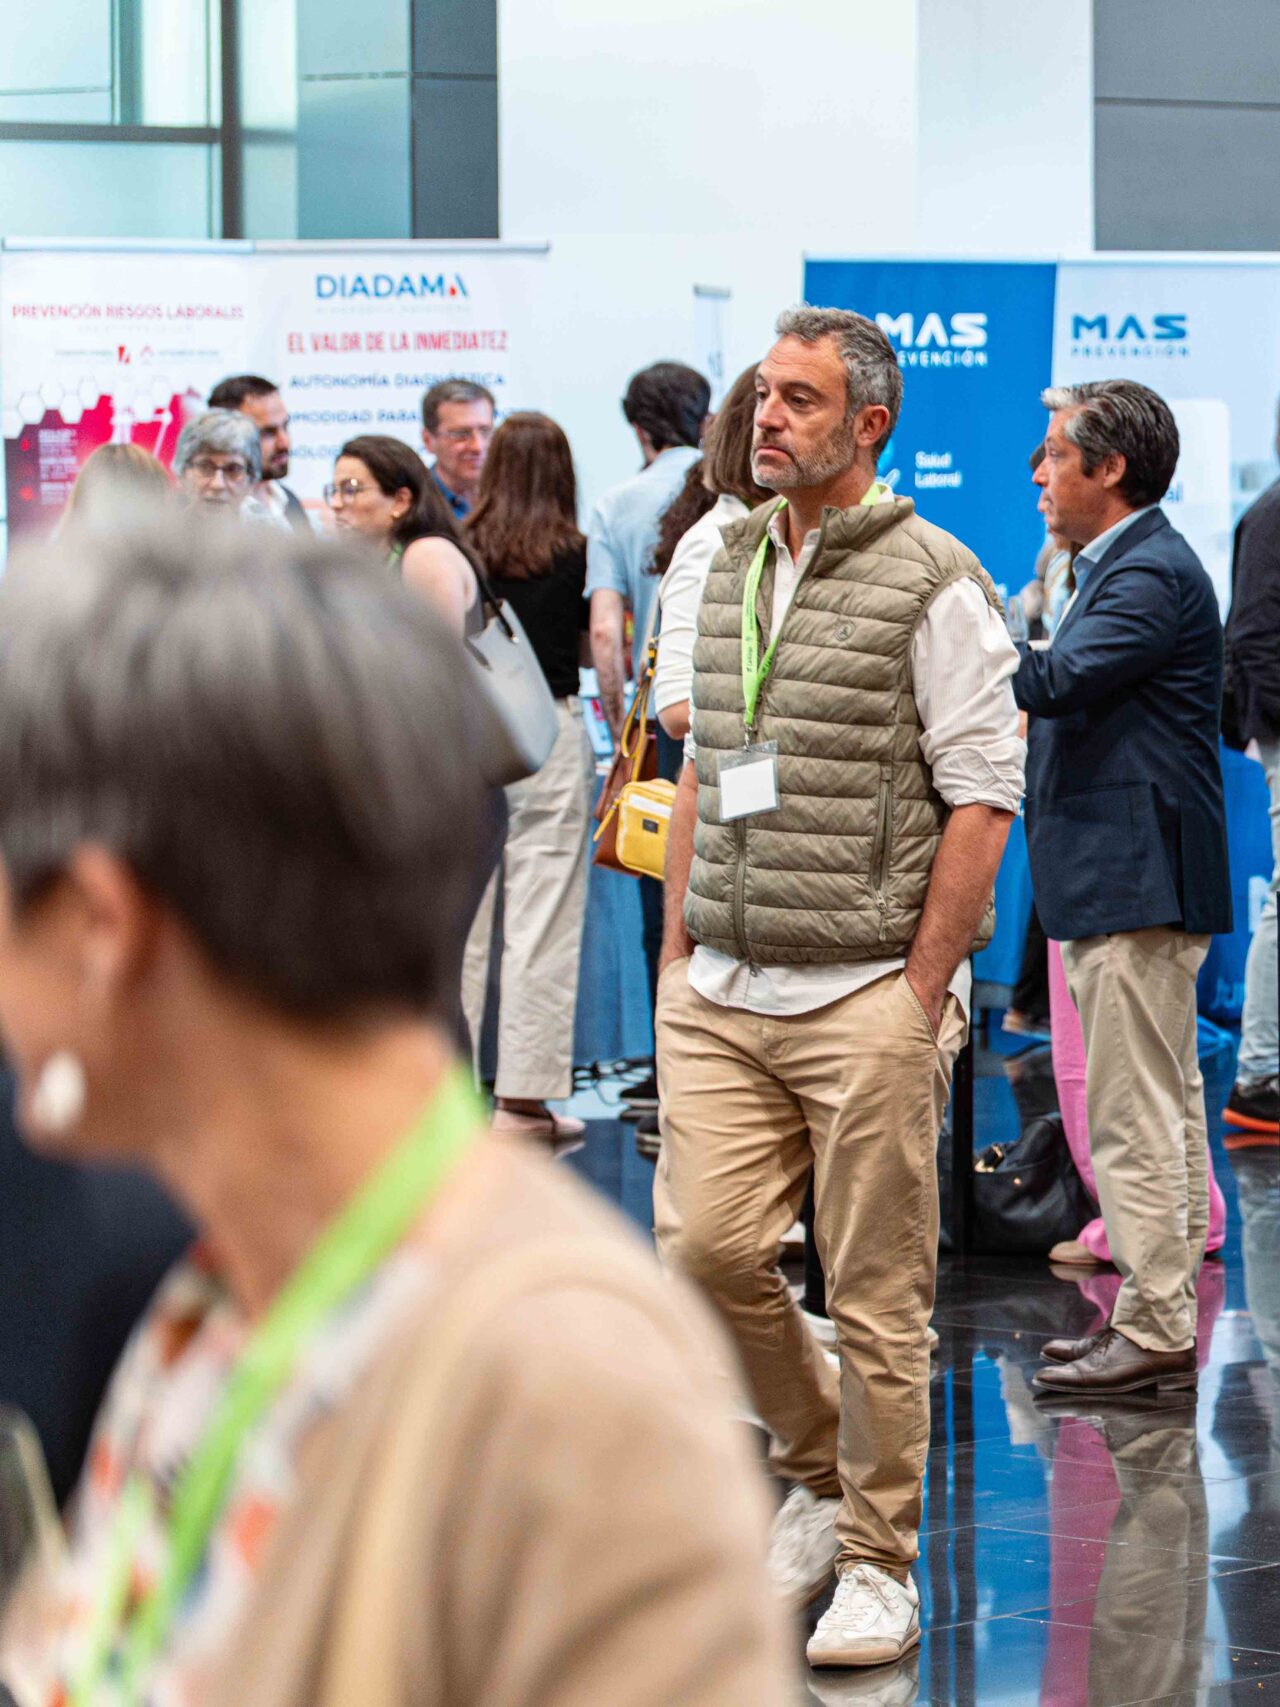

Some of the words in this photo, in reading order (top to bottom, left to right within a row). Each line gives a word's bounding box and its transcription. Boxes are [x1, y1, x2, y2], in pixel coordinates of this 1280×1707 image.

[316, 274, 469, 298] DIADAMA
[106, 304, 163, 319] RIESGOS
[166, 305, 244, 320] LABORALES
[876, 312, 989, 347] MAS
[1072, 314, 1187, 341] MAS
[288, 332, 305, 353] EL
[311, 331, 361, 353] VALOR
[366, 331, 385, 352] DE
[390, 331, 410, 352] LA
[413, 330, 509, 352] INMEDIATEZ
[1070, 343, 1190, 358] PREVENCIÓN
[899, 348, 989, 368] EVENCIÓN
[290, 372, 389, 388] AUTONOMÍA
[915, 451, 952, 469] Salud
[915, 471, 962, 489] Laboral
